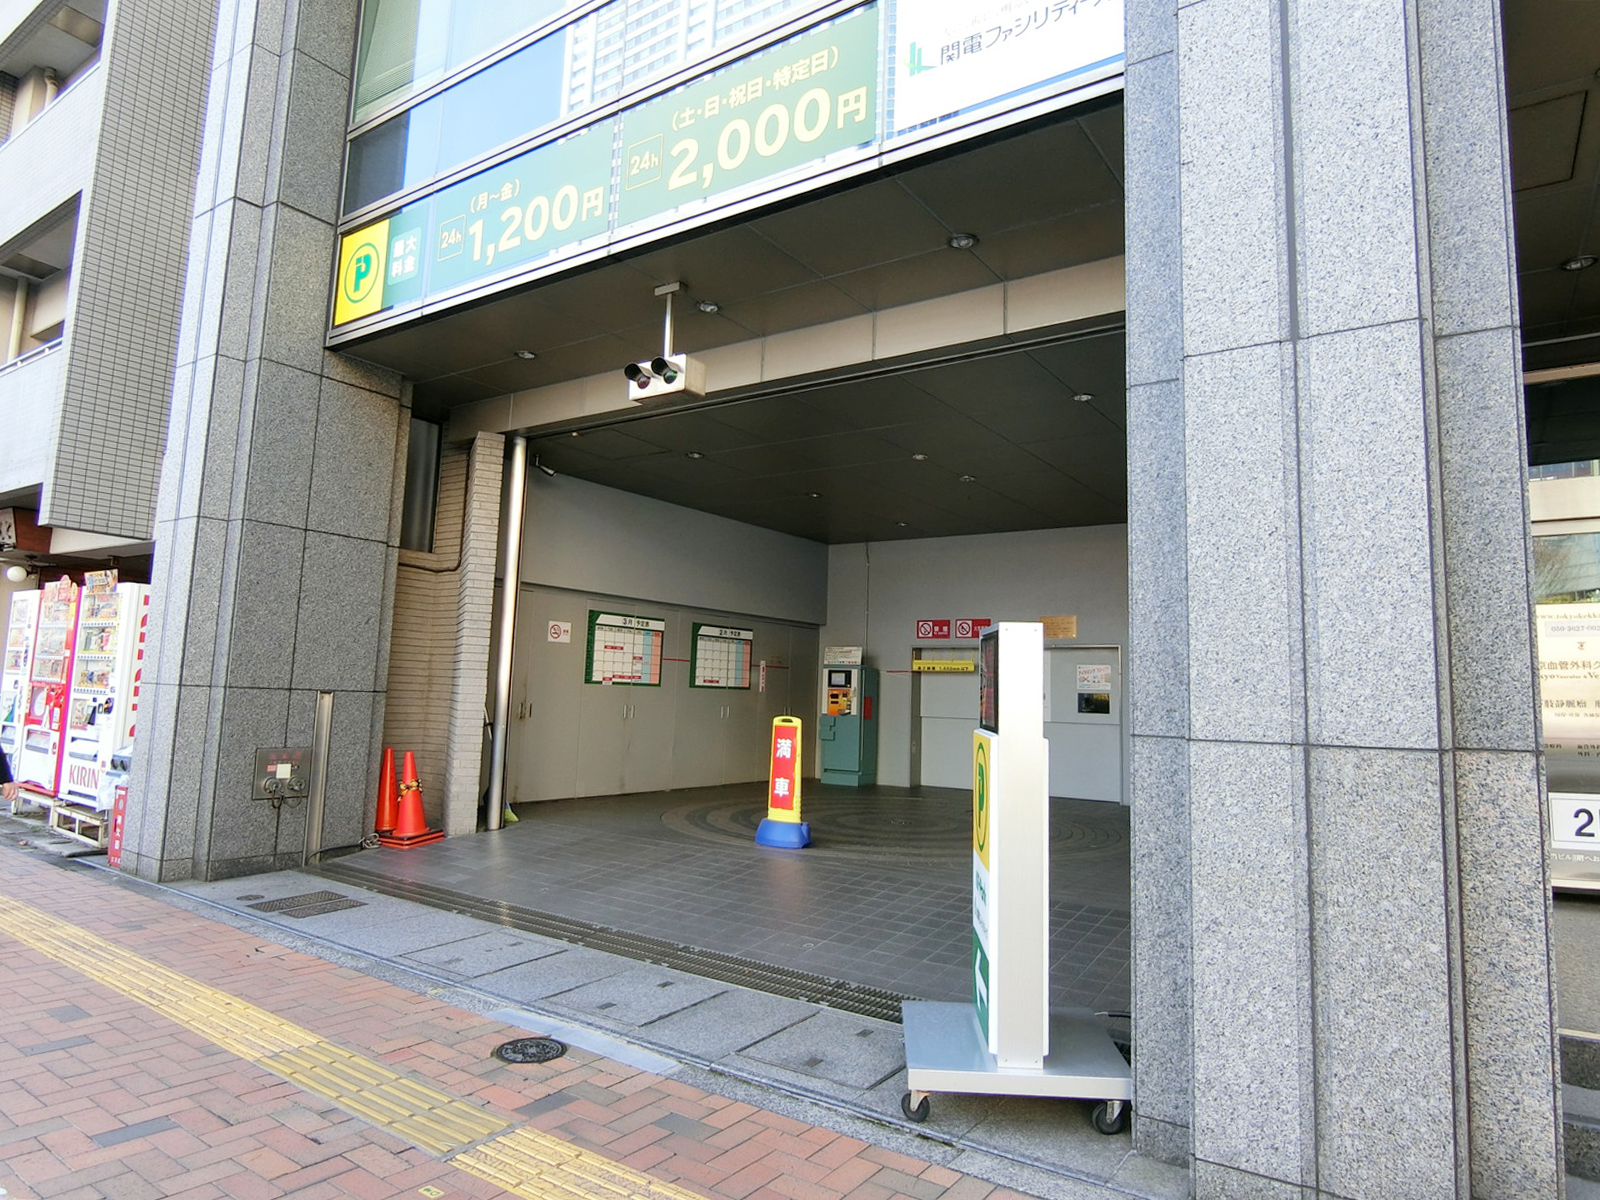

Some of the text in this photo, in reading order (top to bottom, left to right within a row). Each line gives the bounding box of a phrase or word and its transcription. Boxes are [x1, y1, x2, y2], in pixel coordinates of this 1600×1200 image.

[940, 0, 1110, 65] 関電ファシリティー
[630, 86, 868, 191] 24h 2,000円
[393, 235, 418, 258] 最大
[441, 184, 605, 266] 24h 1,200円
[391, 254, 416, 278] 料金
[68, 763, 100, 791] KIRIN
[775, 738, 792, 797] 満車
[1573, 807, 1600, 838] 2
